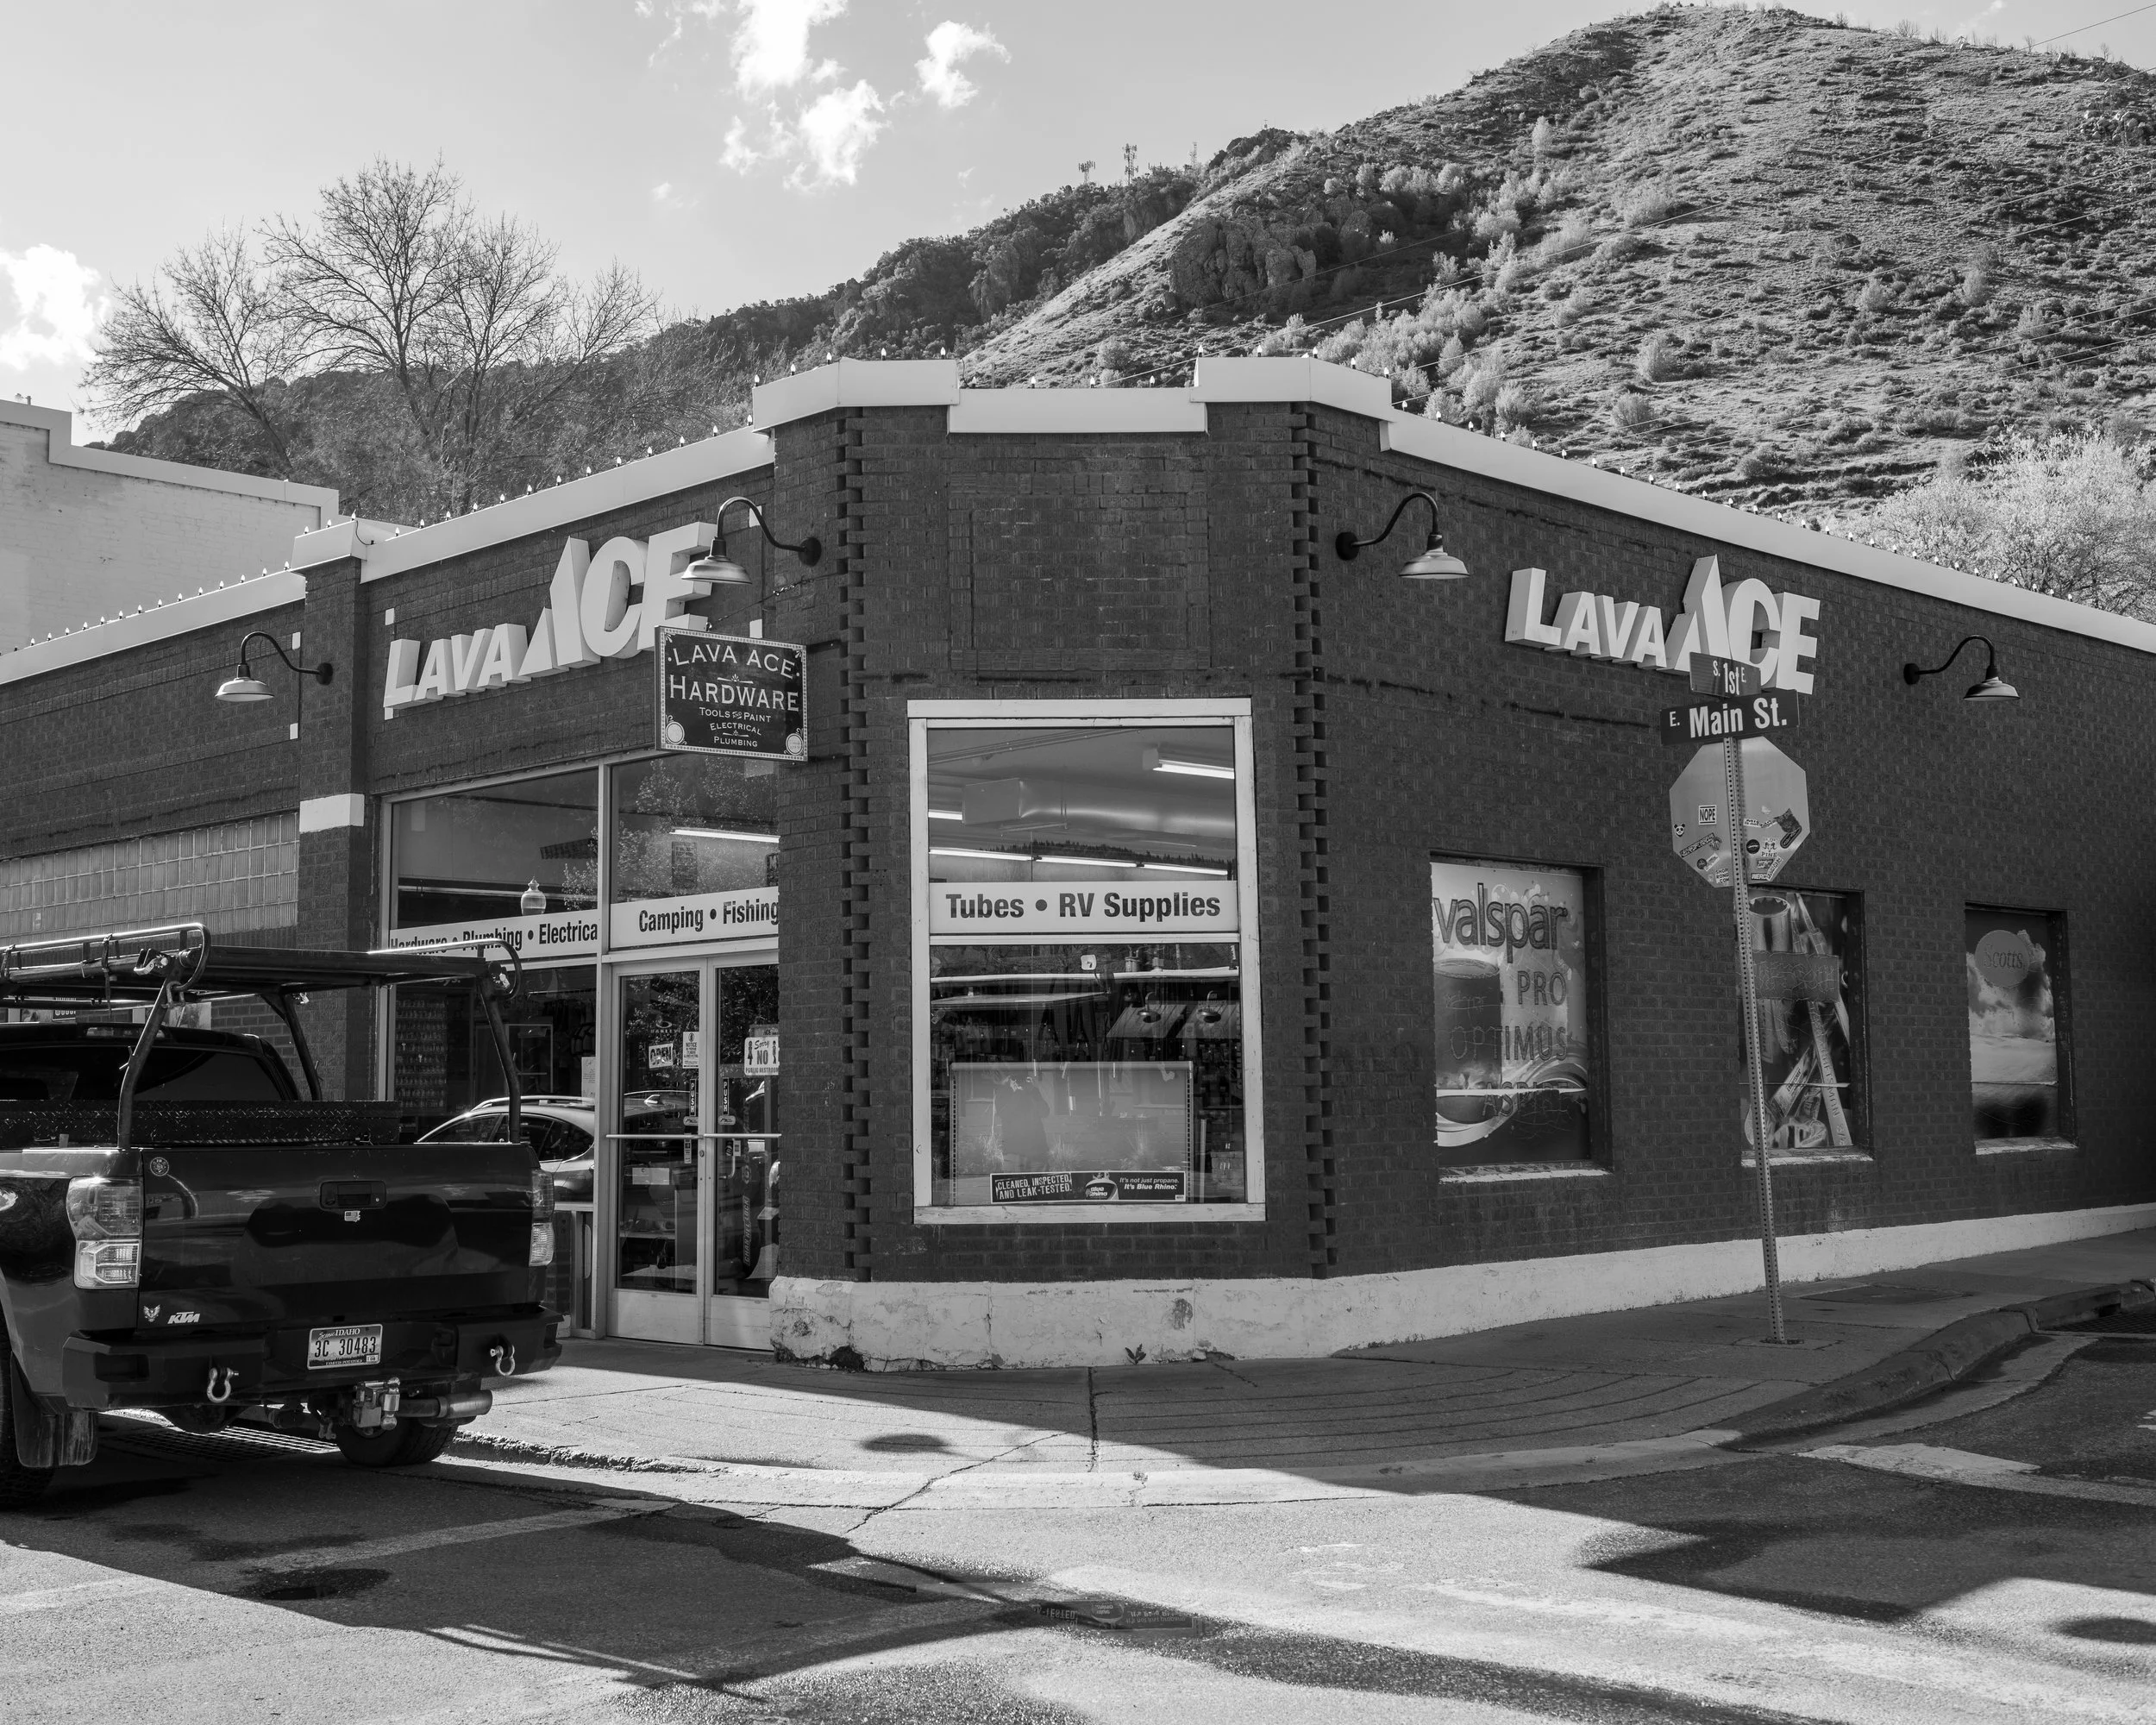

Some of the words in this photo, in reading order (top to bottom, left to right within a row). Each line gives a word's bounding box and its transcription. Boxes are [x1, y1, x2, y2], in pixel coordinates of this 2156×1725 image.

[383, 623, 528, 708] LAVA
[518, 521, 718, 676] ACE
[1505, 568, 1667, 669] LAVA
[1657, 554, 1821, 694] ACE
[673, 644, 737, 666] LAVA
[747, 649, 795, 680] ACE
[670, 674, 799, 712] HARDWARE
[1723, 663, 1739, 695] 1st
[699, 707, 730, 718] TOOLS
[744, 712, 771, 723] PAINT
[710, 722, 762, 736] ELECTRICAL
[1670, 711, 1681, 728] E.
[1689, 703, 1744, 738] Main
[1753, 697, 1788, 729] St.
[713, 736, 758, 748] PLUMBING
[1699, 807, 1716, 821] NOPE
[639, 906, 704, 934] Camping
[723, 896, 779, 925] Fishing
[946, 894, 1025, 919] Tubes
[1059, 893, 1094, 918] RV
[1105, 892, 1220, 922] Supplies
[1433, 882, 1568, 964] valspar
[462, 927, 523, 951] Plumbing
[1983, 944, 2024, 969] Scotts
[1517, 970, 1567, 1007] PRO
[757, 1050, 768, 1064] NO
[1450, 1026, 1569, 1062] OPTIMUS
[1000, 1189, 1014, 1200] AND
[1018, 1182, 1072, 1197] LEAK-TESTED.
[167, 1311, 200, 1324] KTM
[315, 1339, 329, 1358] 3C
[339, 1336, 376, 1355] 30483
